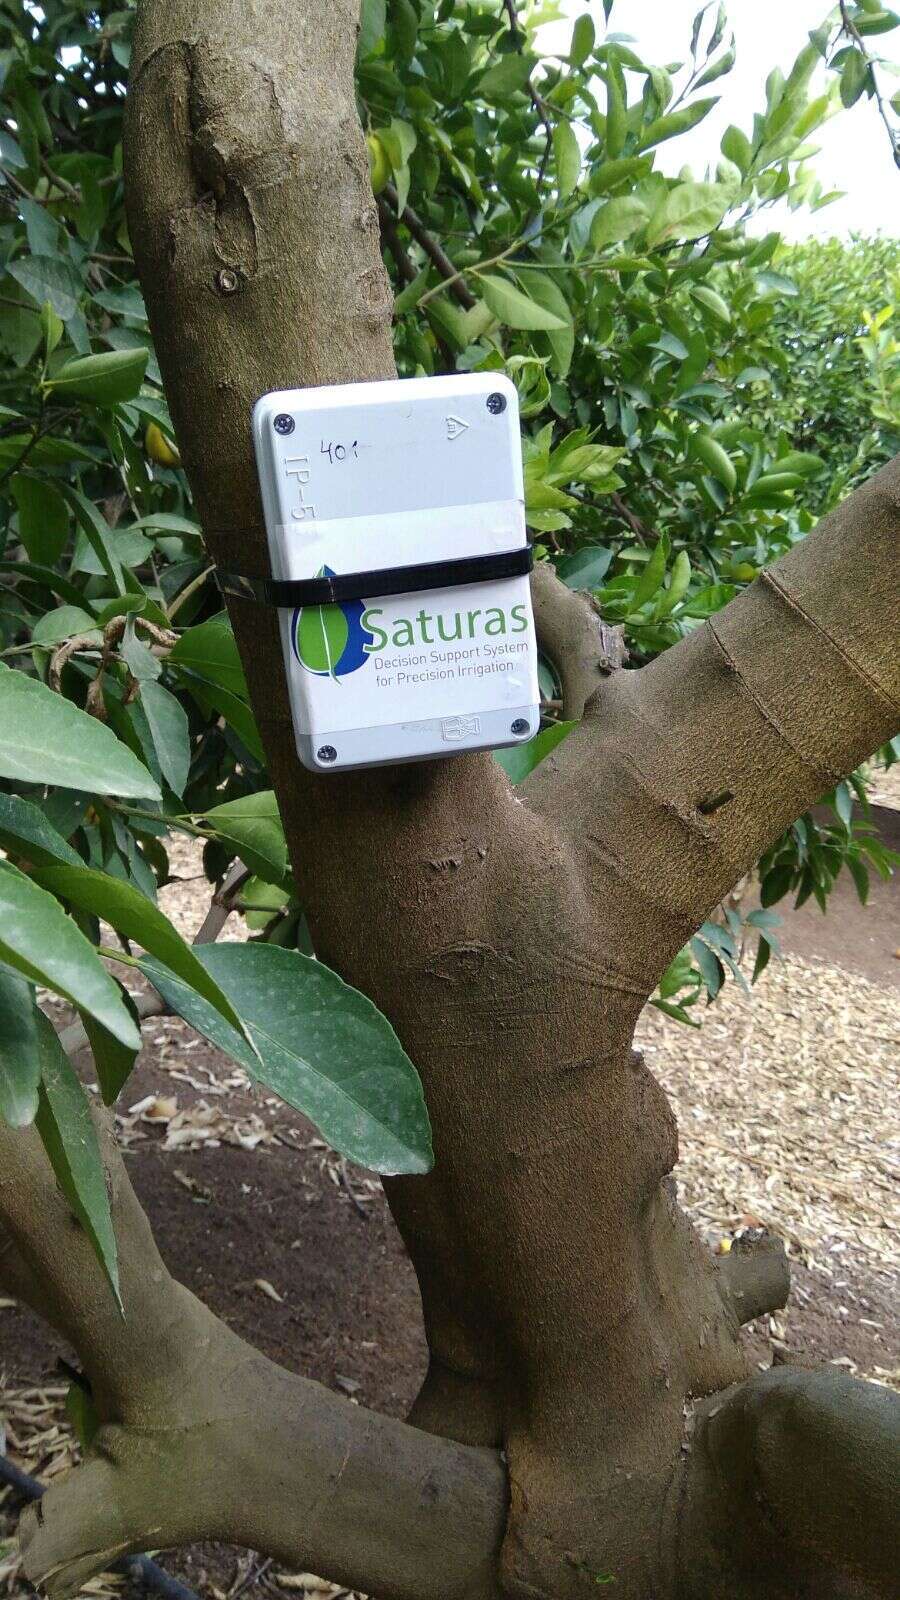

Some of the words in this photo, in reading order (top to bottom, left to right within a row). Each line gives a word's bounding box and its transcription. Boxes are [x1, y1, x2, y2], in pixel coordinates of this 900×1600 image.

[361, 604, 529, 653] Saturas
[374, 654, 427, 670] Decision
[430, 647, 480, 665] Support
[483, 641, 529, 658] System
[376, 674, 394, 687] for
[397, 668, 455, 685] Precision
[458, 660, 514, 678] Irrigation
